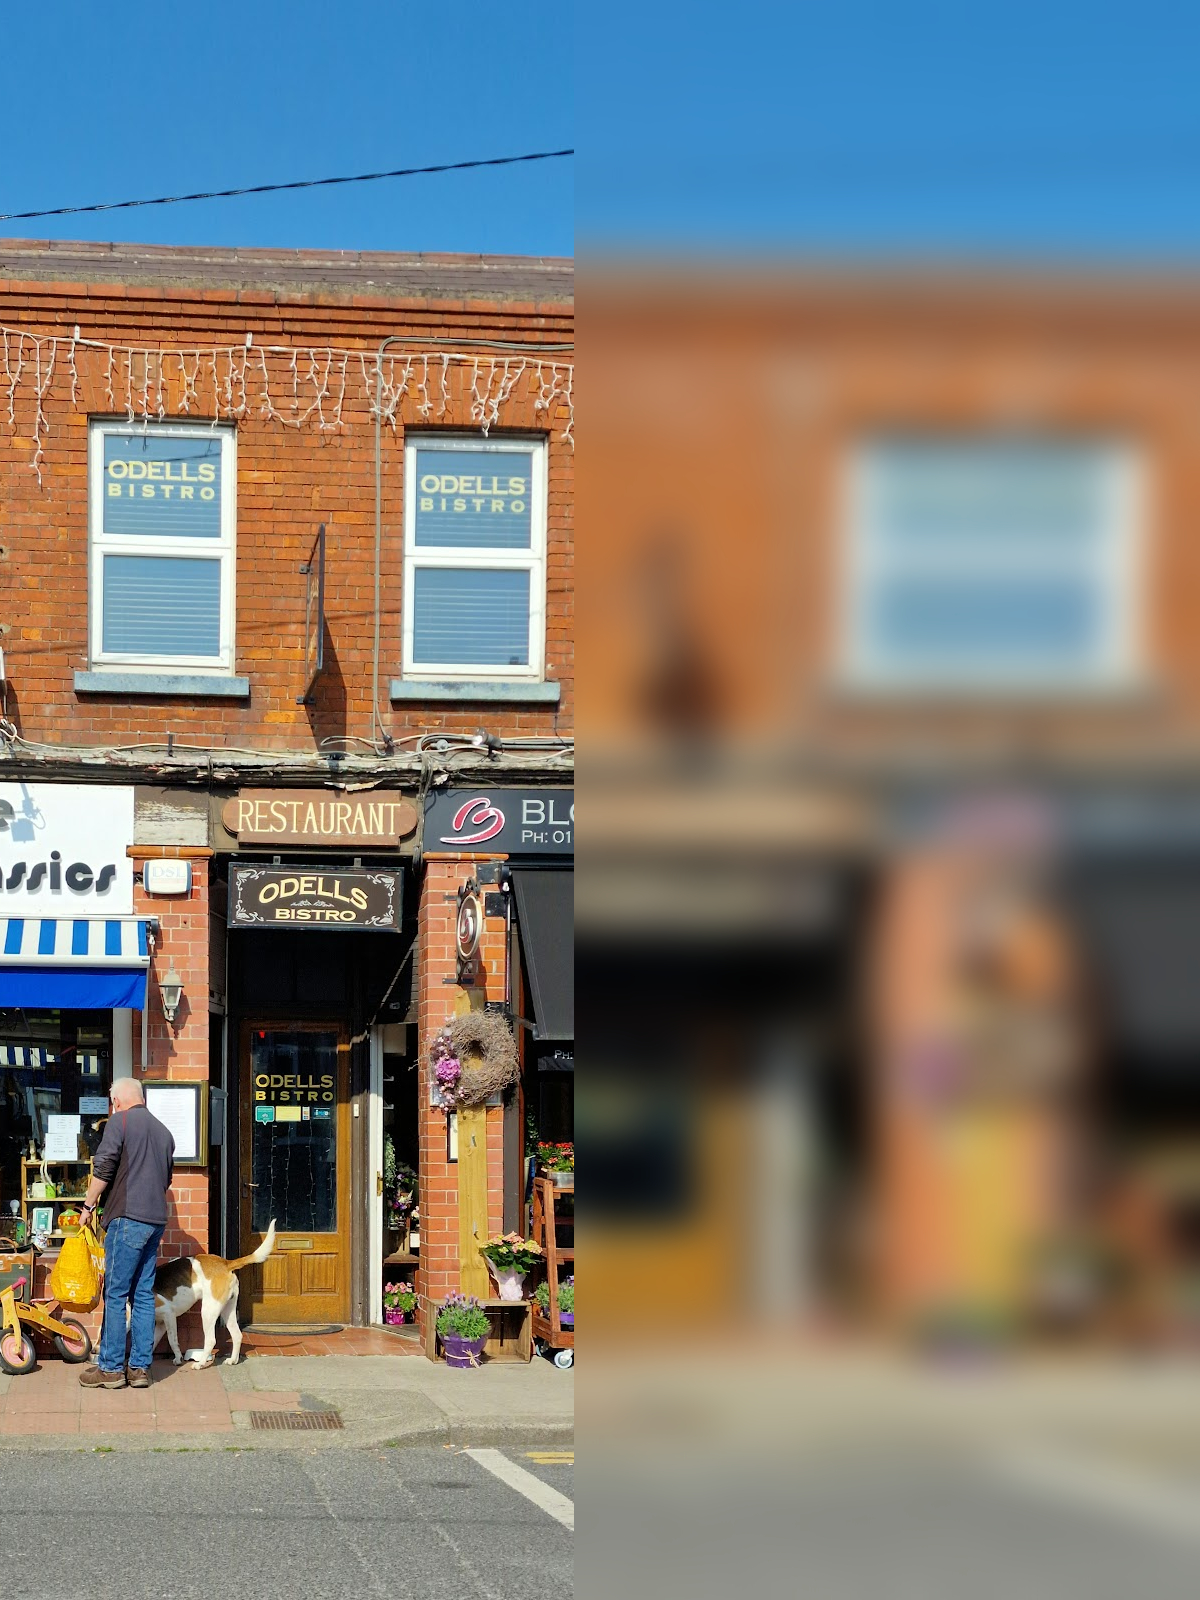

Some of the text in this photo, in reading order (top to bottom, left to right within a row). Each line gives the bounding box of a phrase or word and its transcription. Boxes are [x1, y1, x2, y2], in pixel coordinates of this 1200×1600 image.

[107, 460, 216, 482] ODELLS
[107, 483, 215, 500] BISTRO
[420, 475, 526, 496] ODELLS
[420, 497, 526, 513] BISTRO
[237, 799, 401, 836] RESTAURANT
[521, 799, 574, 826] BL
[152, 866, 186, 878] DSL
[258, 876, 368, 910] ODELLS
[275, 908, 357, 922] BISTRO
[255, 1074, 334, 1088] ODELLS
[255, 1090, 334, 1101] BISTRO
